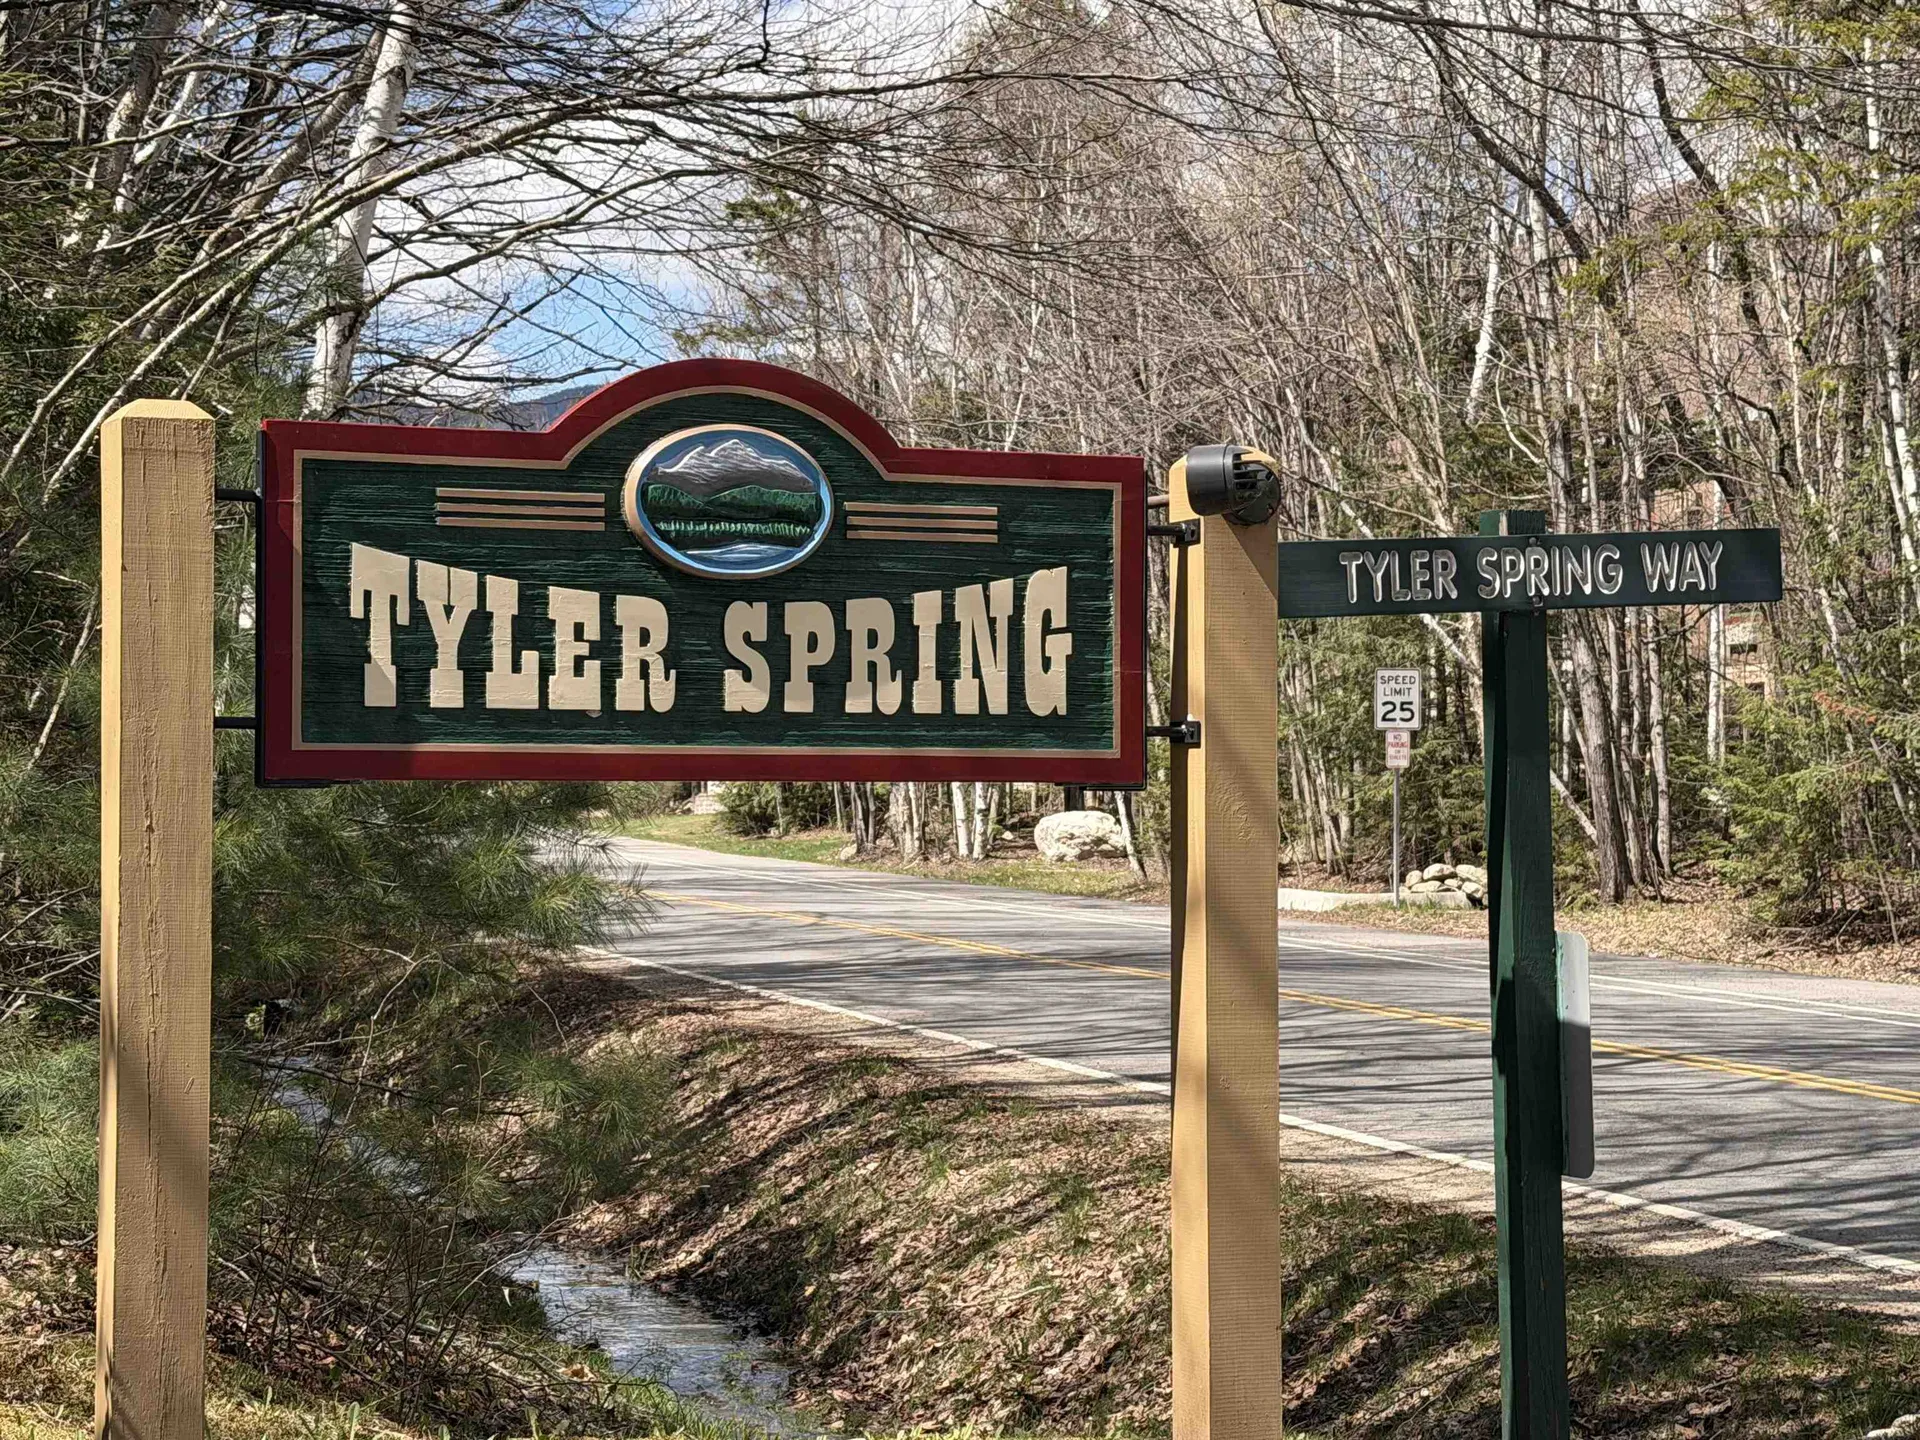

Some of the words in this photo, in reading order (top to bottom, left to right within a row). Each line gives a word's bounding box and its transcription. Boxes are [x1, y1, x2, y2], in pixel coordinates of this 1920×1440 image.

[1339, 549, 1458, 604] TYLER
[1477, 543, 1624, 599] SPRING
[1641, 540, 1724, 593] WAY
[350, 542, 676, 713] TYLER
[722, 566, 1073, 717] SPRING
[1380, 675, 1416, 685] SPEED
[1383, 687, 1412, 697] LIMIT
[1381, 700, 1415, 723] 25
